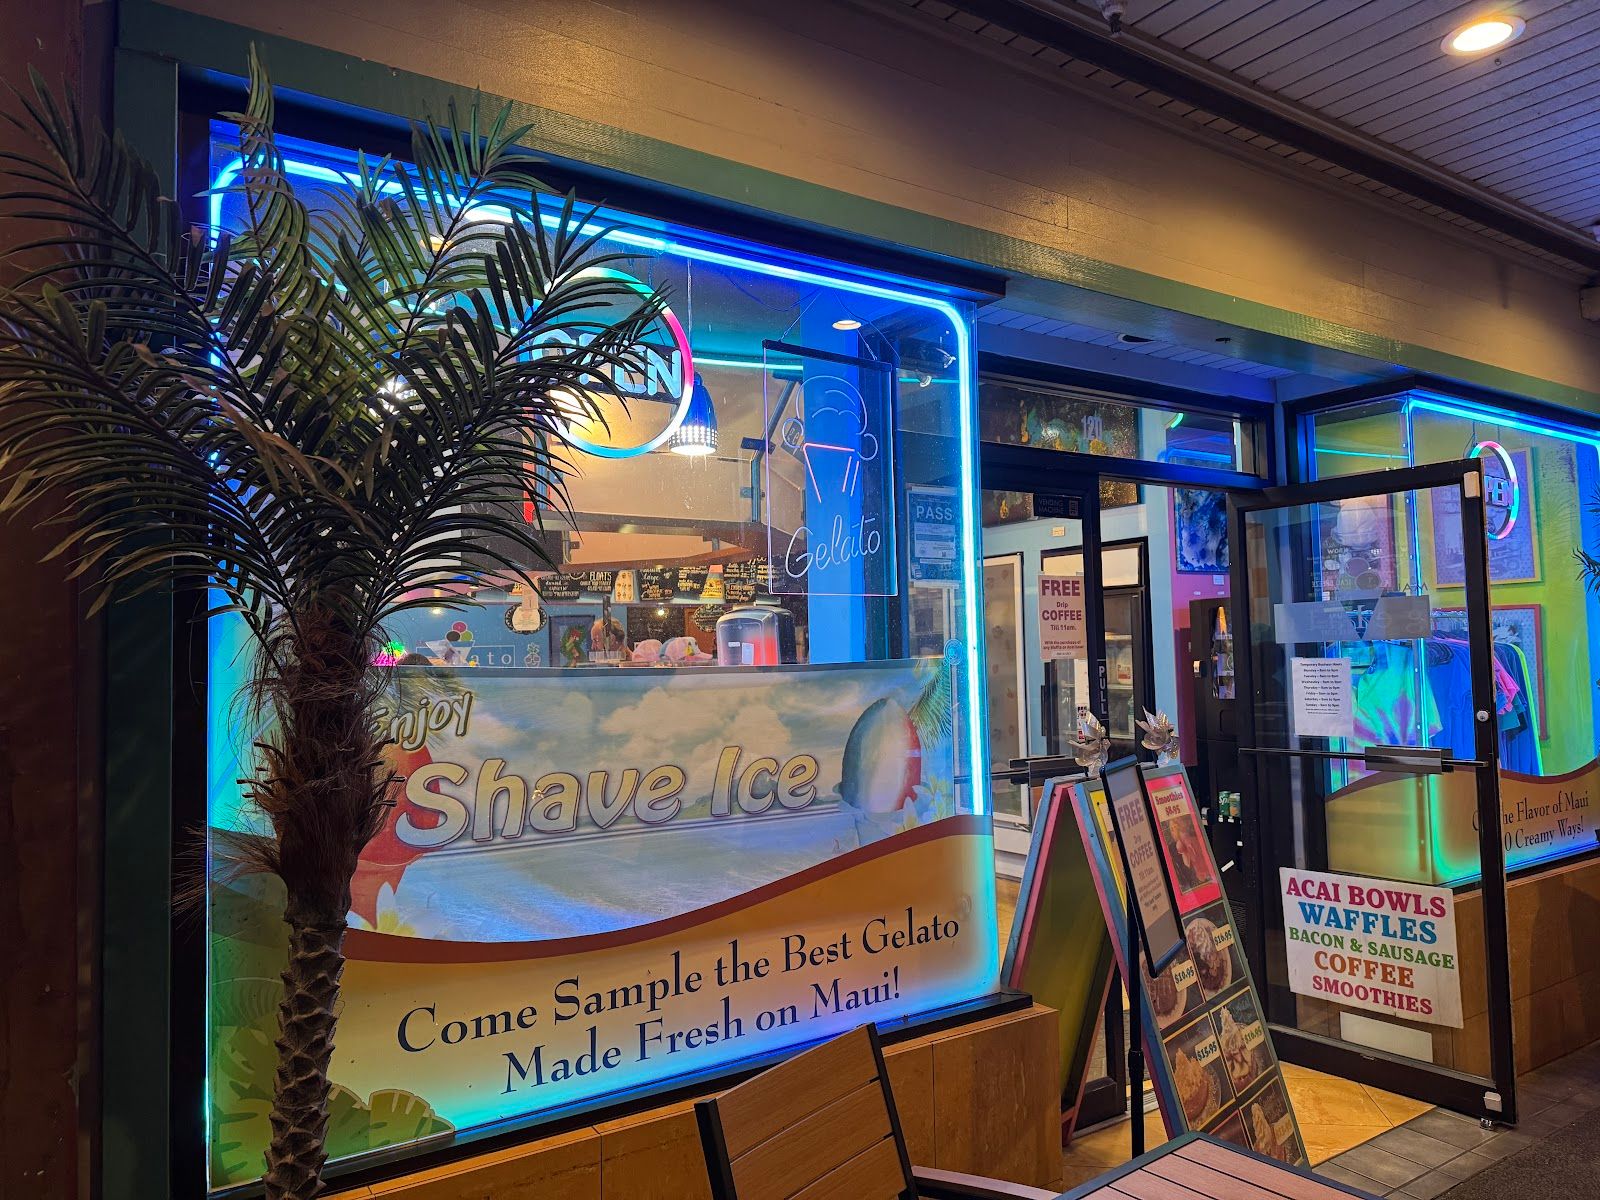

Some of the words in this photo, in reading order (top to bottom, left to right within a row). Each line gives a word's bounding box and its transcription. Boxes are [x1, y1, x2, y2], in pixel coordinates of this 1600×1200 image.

[1484, 475, 1515, 506] PEN
[916, 505, 953, 521] PASS
[785, 514, 881, 579] Gelato
[589, 571, 612, 581] FLOATS
[1041, 579, 1081, 597] FREE
[1041, 609, 1082, 621] COFFEE
[1056, 601, 1069, 609] Drip
[1098, 665, 1107, 715] PULL
[395, 758, 686, 848] Shave
[710, 745, 819, 817] Ice
[1154, 791, 1184, 806] Smoothies
[1501, 799, 1514, 825] he
[1516, 797, 1550, 822] Flavor
[1552, 790, 1563, 814] of
[1564, 790, 1589, 812] Maui
[1117, 799, 1145, 832] FREE
[1504, 831, 1512, 851] 0
[1515, 828, 1555, 849] Creamy
[1557, 815, 1584, 840] Ways!
[1129, 840, 1154, 868] COFFEE
[1286, 877, 1341, 903] ACAI
[1347, 885, 1446, 918] BOWLS
[1298, 901, 1437, 945] WAFFLES
[1288, 926, 1344, 950] BACON
[1350, 938, 1363, 953] &
[1368, 941, 1455, 969] SAUSAGE
[397, 1002, 538, 1053] Come
[553, 950, 702, 1026] Sample
[713, 938, 770, 987] the
[780, 931, 853, 973] Best
[862, 906, 960, 955] Gelato
[1314, 950, 1414, 988] COFFEE
[1312, 975, 1433, 1015] SMOOTHIES
[500, 1025, 622, 1094] Made
[634, 996, 746, 1063] Fresh
[755, 1003, 800, 1032] on
[809, 965, 900, 1020] Maui!
